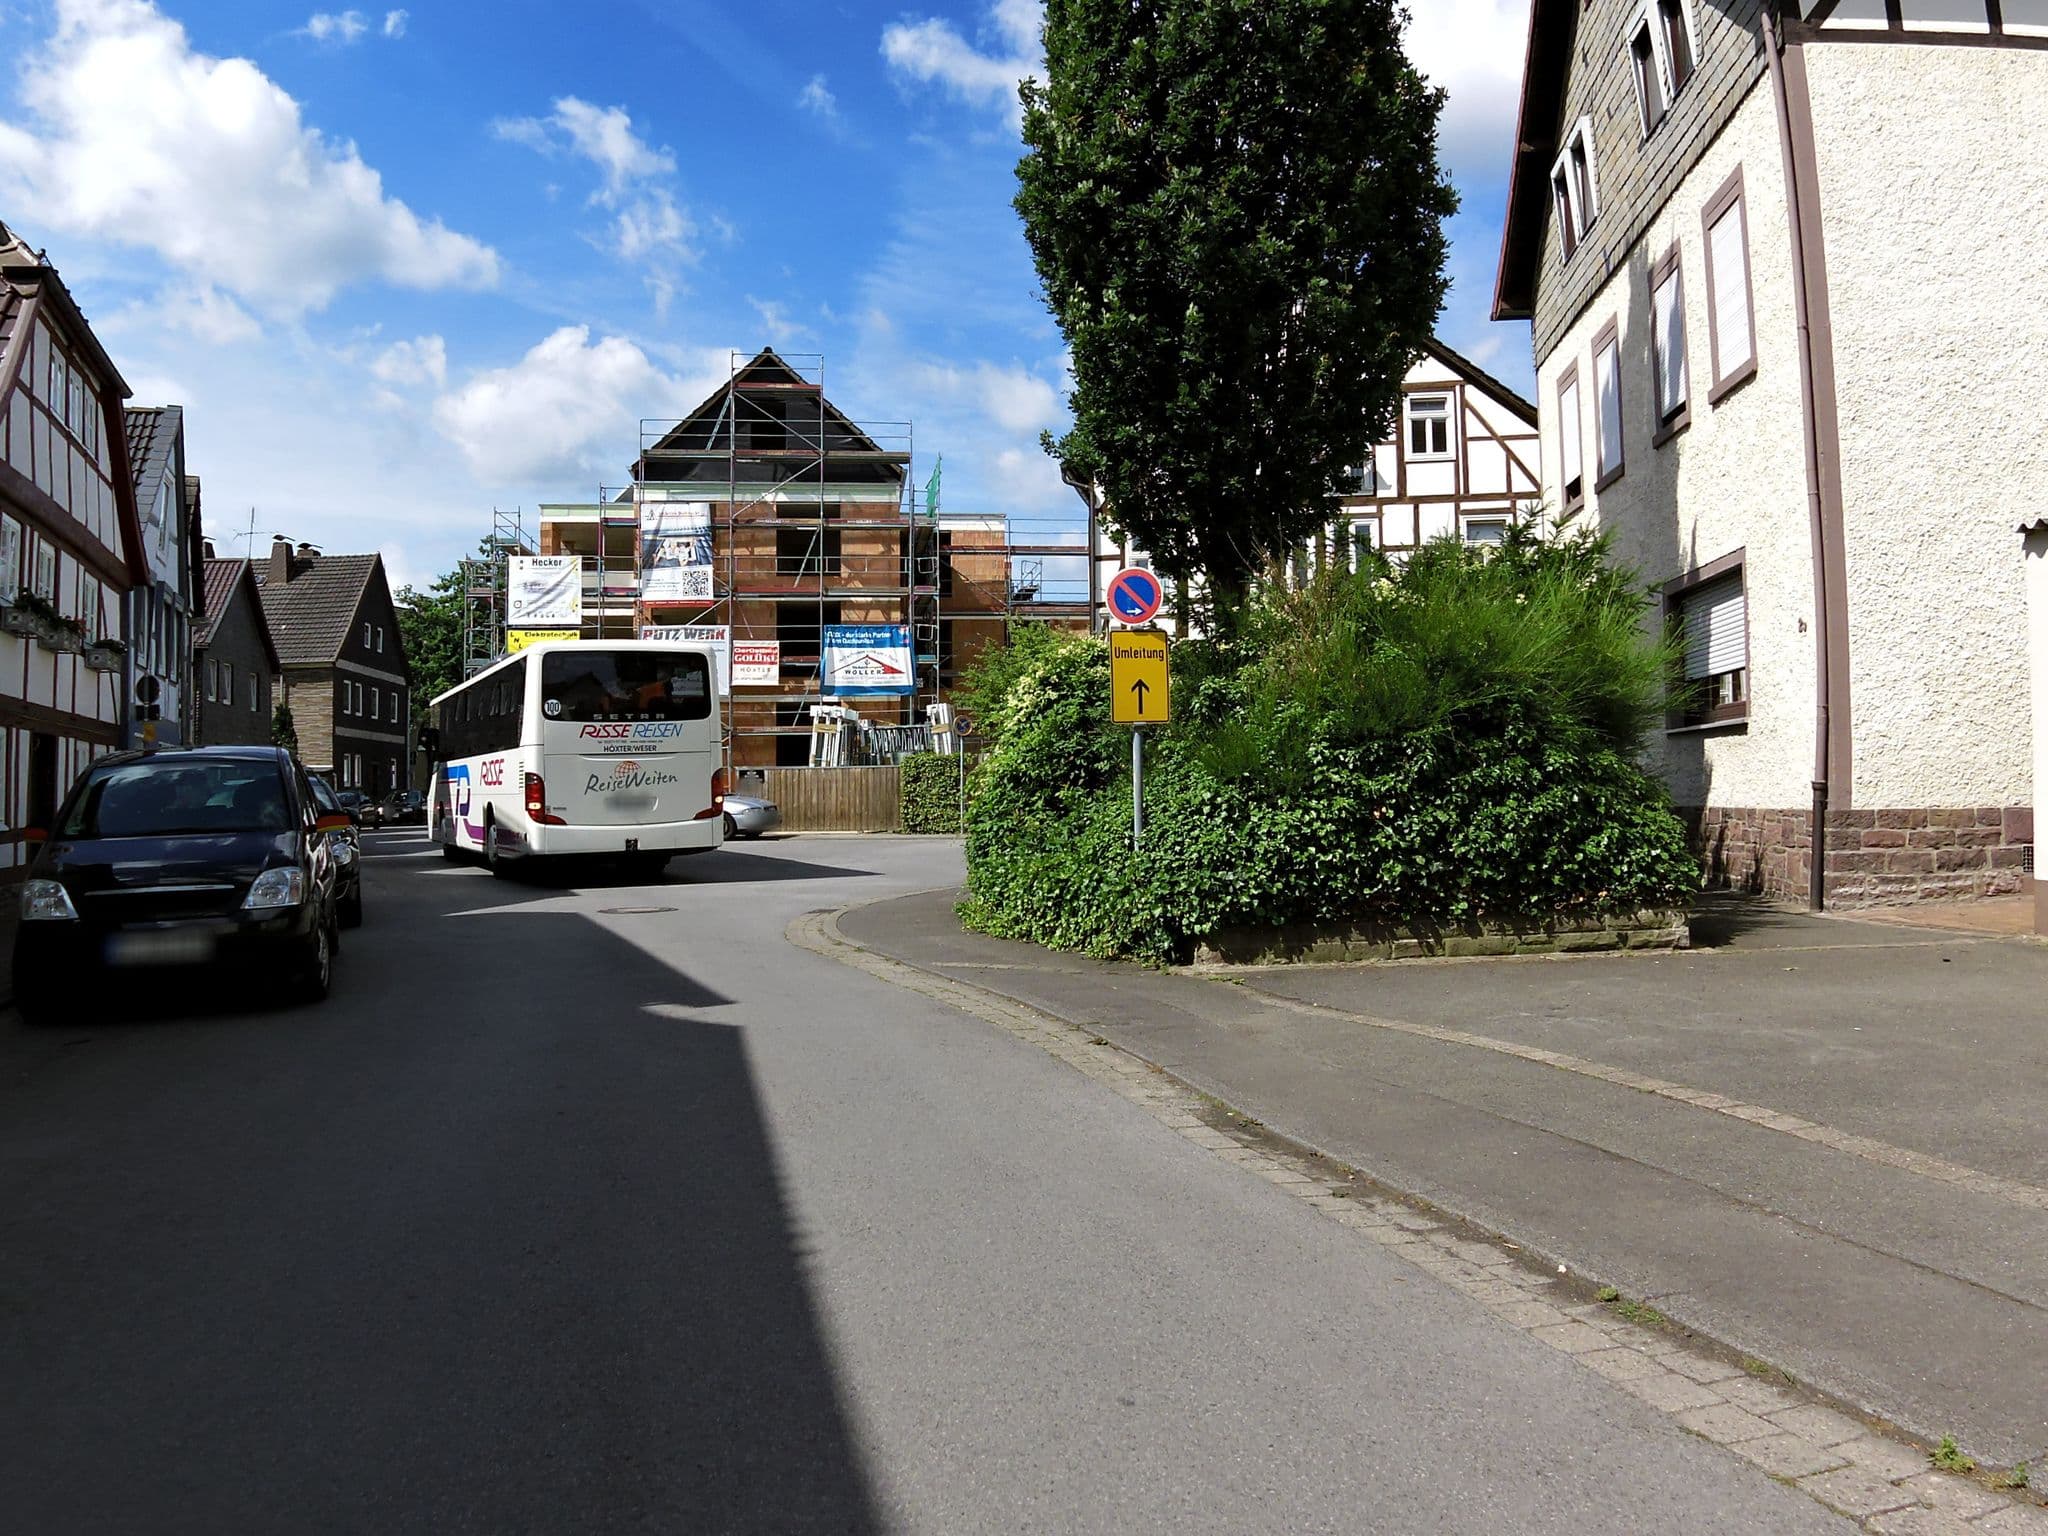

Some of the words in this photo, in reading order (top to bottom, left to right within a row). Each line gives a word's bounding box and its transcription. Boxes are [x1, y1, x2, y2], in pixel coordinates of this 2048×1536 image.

[531, 558, 562, 566] Hecker
[1114, 646, 1164, 661] Umleitung
[546, 702, 560, 713] 100
